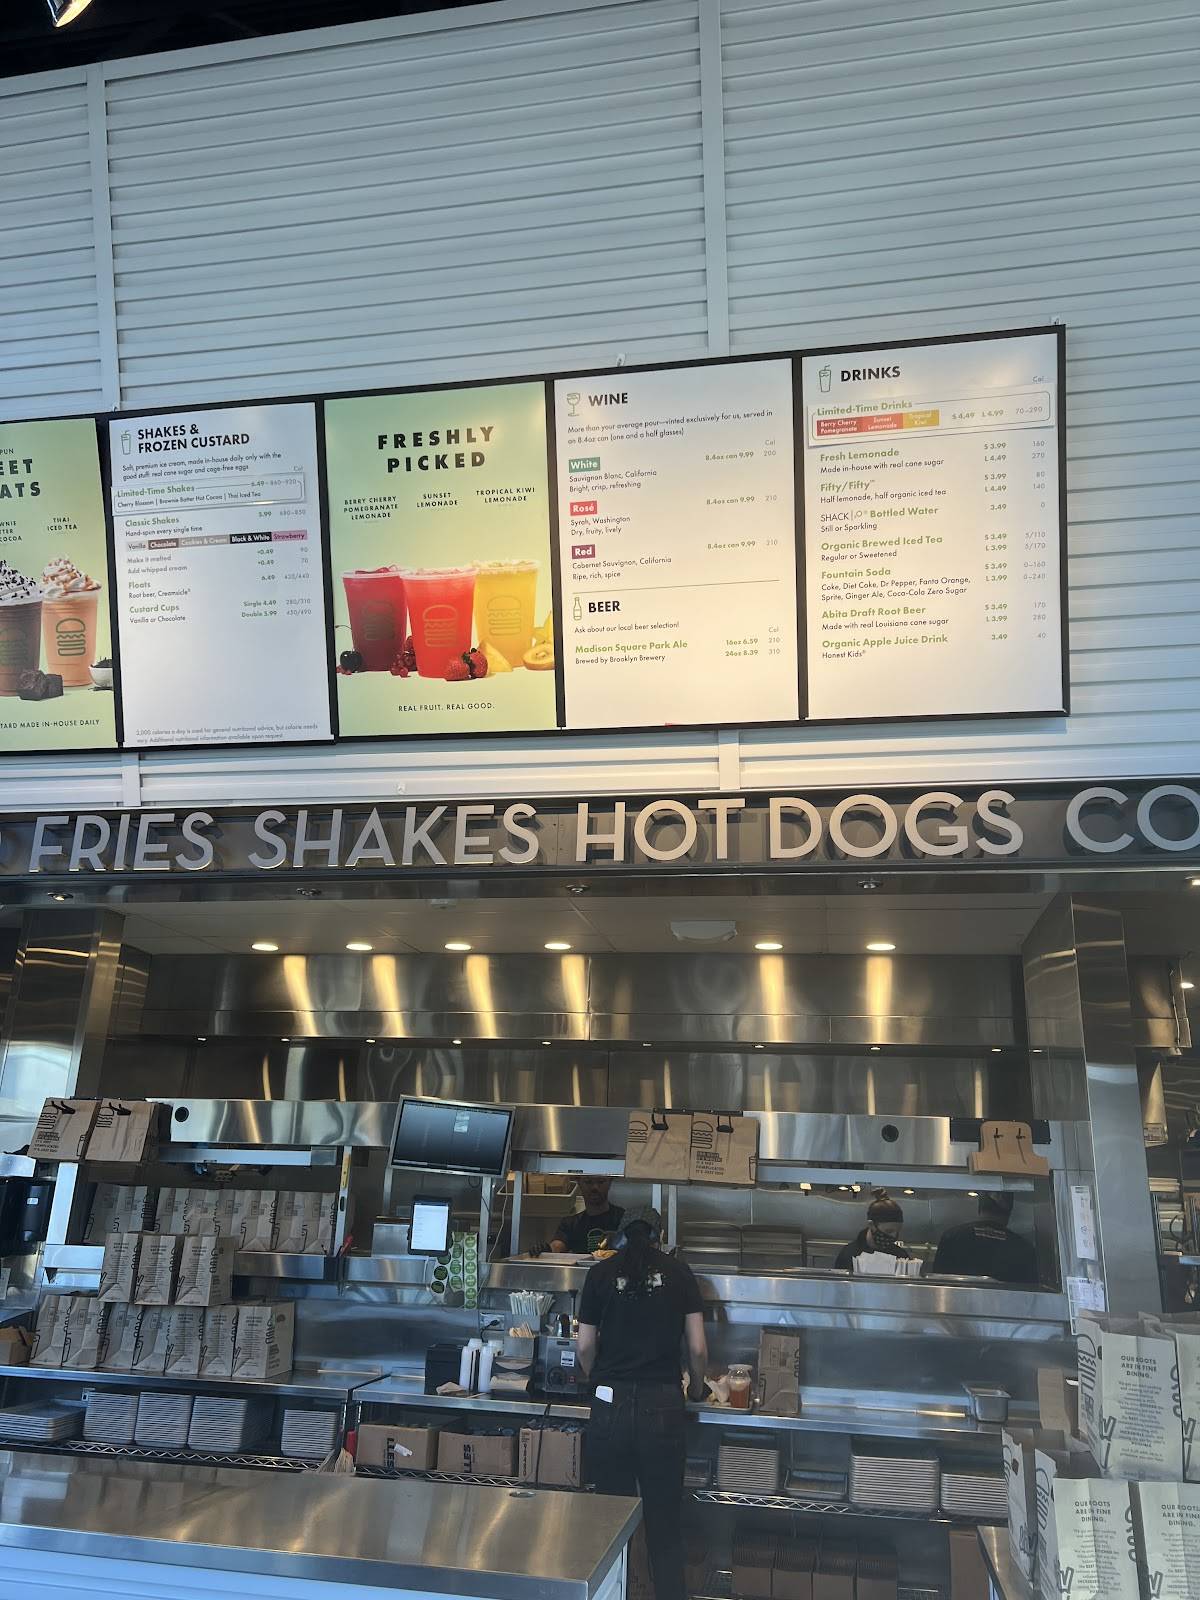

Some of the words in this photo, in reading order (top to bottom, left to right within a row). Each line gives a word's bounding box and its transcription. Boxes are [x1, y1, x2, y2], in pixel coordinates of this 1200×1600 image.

[841, 366, 900, 382] DRINKS
[588, 393, 628, 407] WINE
[817, 404, 878, 416] Limited-Time
[881, 401, 912, 410] Drinks
[568, 426, 584, 434] More
[601, 424, 615, 433] your
[617, 421, 643, 430] average
[686, 413, 720, 424] exclusively
[732, 412, 741, 420] us,
[743, 410, 764, 418] served
[137, 425, 186, 440] SHAKES
[190, 424, 199, 434] &
[378, 426, 494, 450] FRESHLY
[138, 439, 187, 453] FROZEN
[191, 434, 249, 448] CUSTARD
[820, 453, 846, 462] Fresh
[848, 449, 899, 460] Lemonade
[387, 452, 485, 473] PICKED
[570, 460, 597, 469] White
[820, 466, 841, 474] Made
[842, 464, 872, 472] in-house
[874, 462, 888, 470] with
[889, 460, 904, 468] real
[924, 459, 944, 468] sugar
[569, 474, 603, 483] Sauvignon
[604, 472, 623, 481] Blanc,
[625, 469, 657, 478] California
[0, 482, 40, 498] ATS
[117, 487, 165, 498] Limited-Time
[167, 485, 194, 494] Shakes
[476, 488, 513, 496] TROPICAL
[569, 484, 590, 493] Bright,
[609, 481, 641, 490] refreshing
[423, 492, 451, 500] SUNSET
[344, 503, 398, 513] POMEGRANATE
[416, 500, 458, 508] LEMONADE
[573, 504, 594, 513] Rosé
[351, 512, 391, 520] LEMONADE
[592, 515, 630, 525] Washington
[820, 512, 849, 522] SHACK
[870, 509, 906, 518] Bottled
[908, 507, 938, 516] Water
[125, 518, 150, 527] Classic
[152, 517, 179, 525] Shakes
[844, 522, 878, 532] Sparkling
[605, 526, 622, 534] lively
[150, 540, 177, 548] Chocolate
[231, 535, 249, 543] Black
[821, 540, 861, 551] Organic
[862, 537, 901, 548] Brewed
[903, 537, 923, 546] Iced
[926, 535, 943, 544] Tea
[575, 548, 592, 556] Red
[821, 554, 848, 562] Regular
[859, 550, 897, 559] Sweetened
[572, 562, 601, 570] Cabernet
[639, 556, 672, 565] California
[821, 569, 863, 580] Fountain
[866, 567, 891, 577] Soda
[128, 581, 151, 589] Floats
[821, 583, 841, 592] Coke,
[858, 581, 878, 589] Coke,
[891, 579, 917, 588] Pepper,
[940, 576, 971, 585] Orange,
[130, 604, 159, 614] Custard
[161, 604, 179, 613] Cups
[588, 600, 621, 613] BEER
[822, 609, 848, 619] Abita
[850, 607, 875, 617] Draft
[877, 607, 900, 615] Root
[903, 605, 926, 614] Beer
[130, 616, 149, 624] Vanilla
[158, 614, 186, 622] Chocolate
[587, 625, 605, 633] about
[575, 644, 613, 654] Madison
[615, 642, 647, 652] Square
[649, 641, 670, 650] Park
[672, 640, 688, 648] Ale
[822, 638, 861, 649] Organic
[863, 636, 892, 646] Apple
[894, 636, 919, 645] Juice
[921, 634, 948, 644] Drink
[609, 655, 638, 663] Brooklyn
[639, 654, 666, 663] Brewery
[822, 651, 846, 659] Honest
[576, 798, 745, 862] HOT
[770, 790, 1024, 859] DOGS
[29, 809, 214, 872] FRIES
[248, 804, 538, 868] SHAKES
